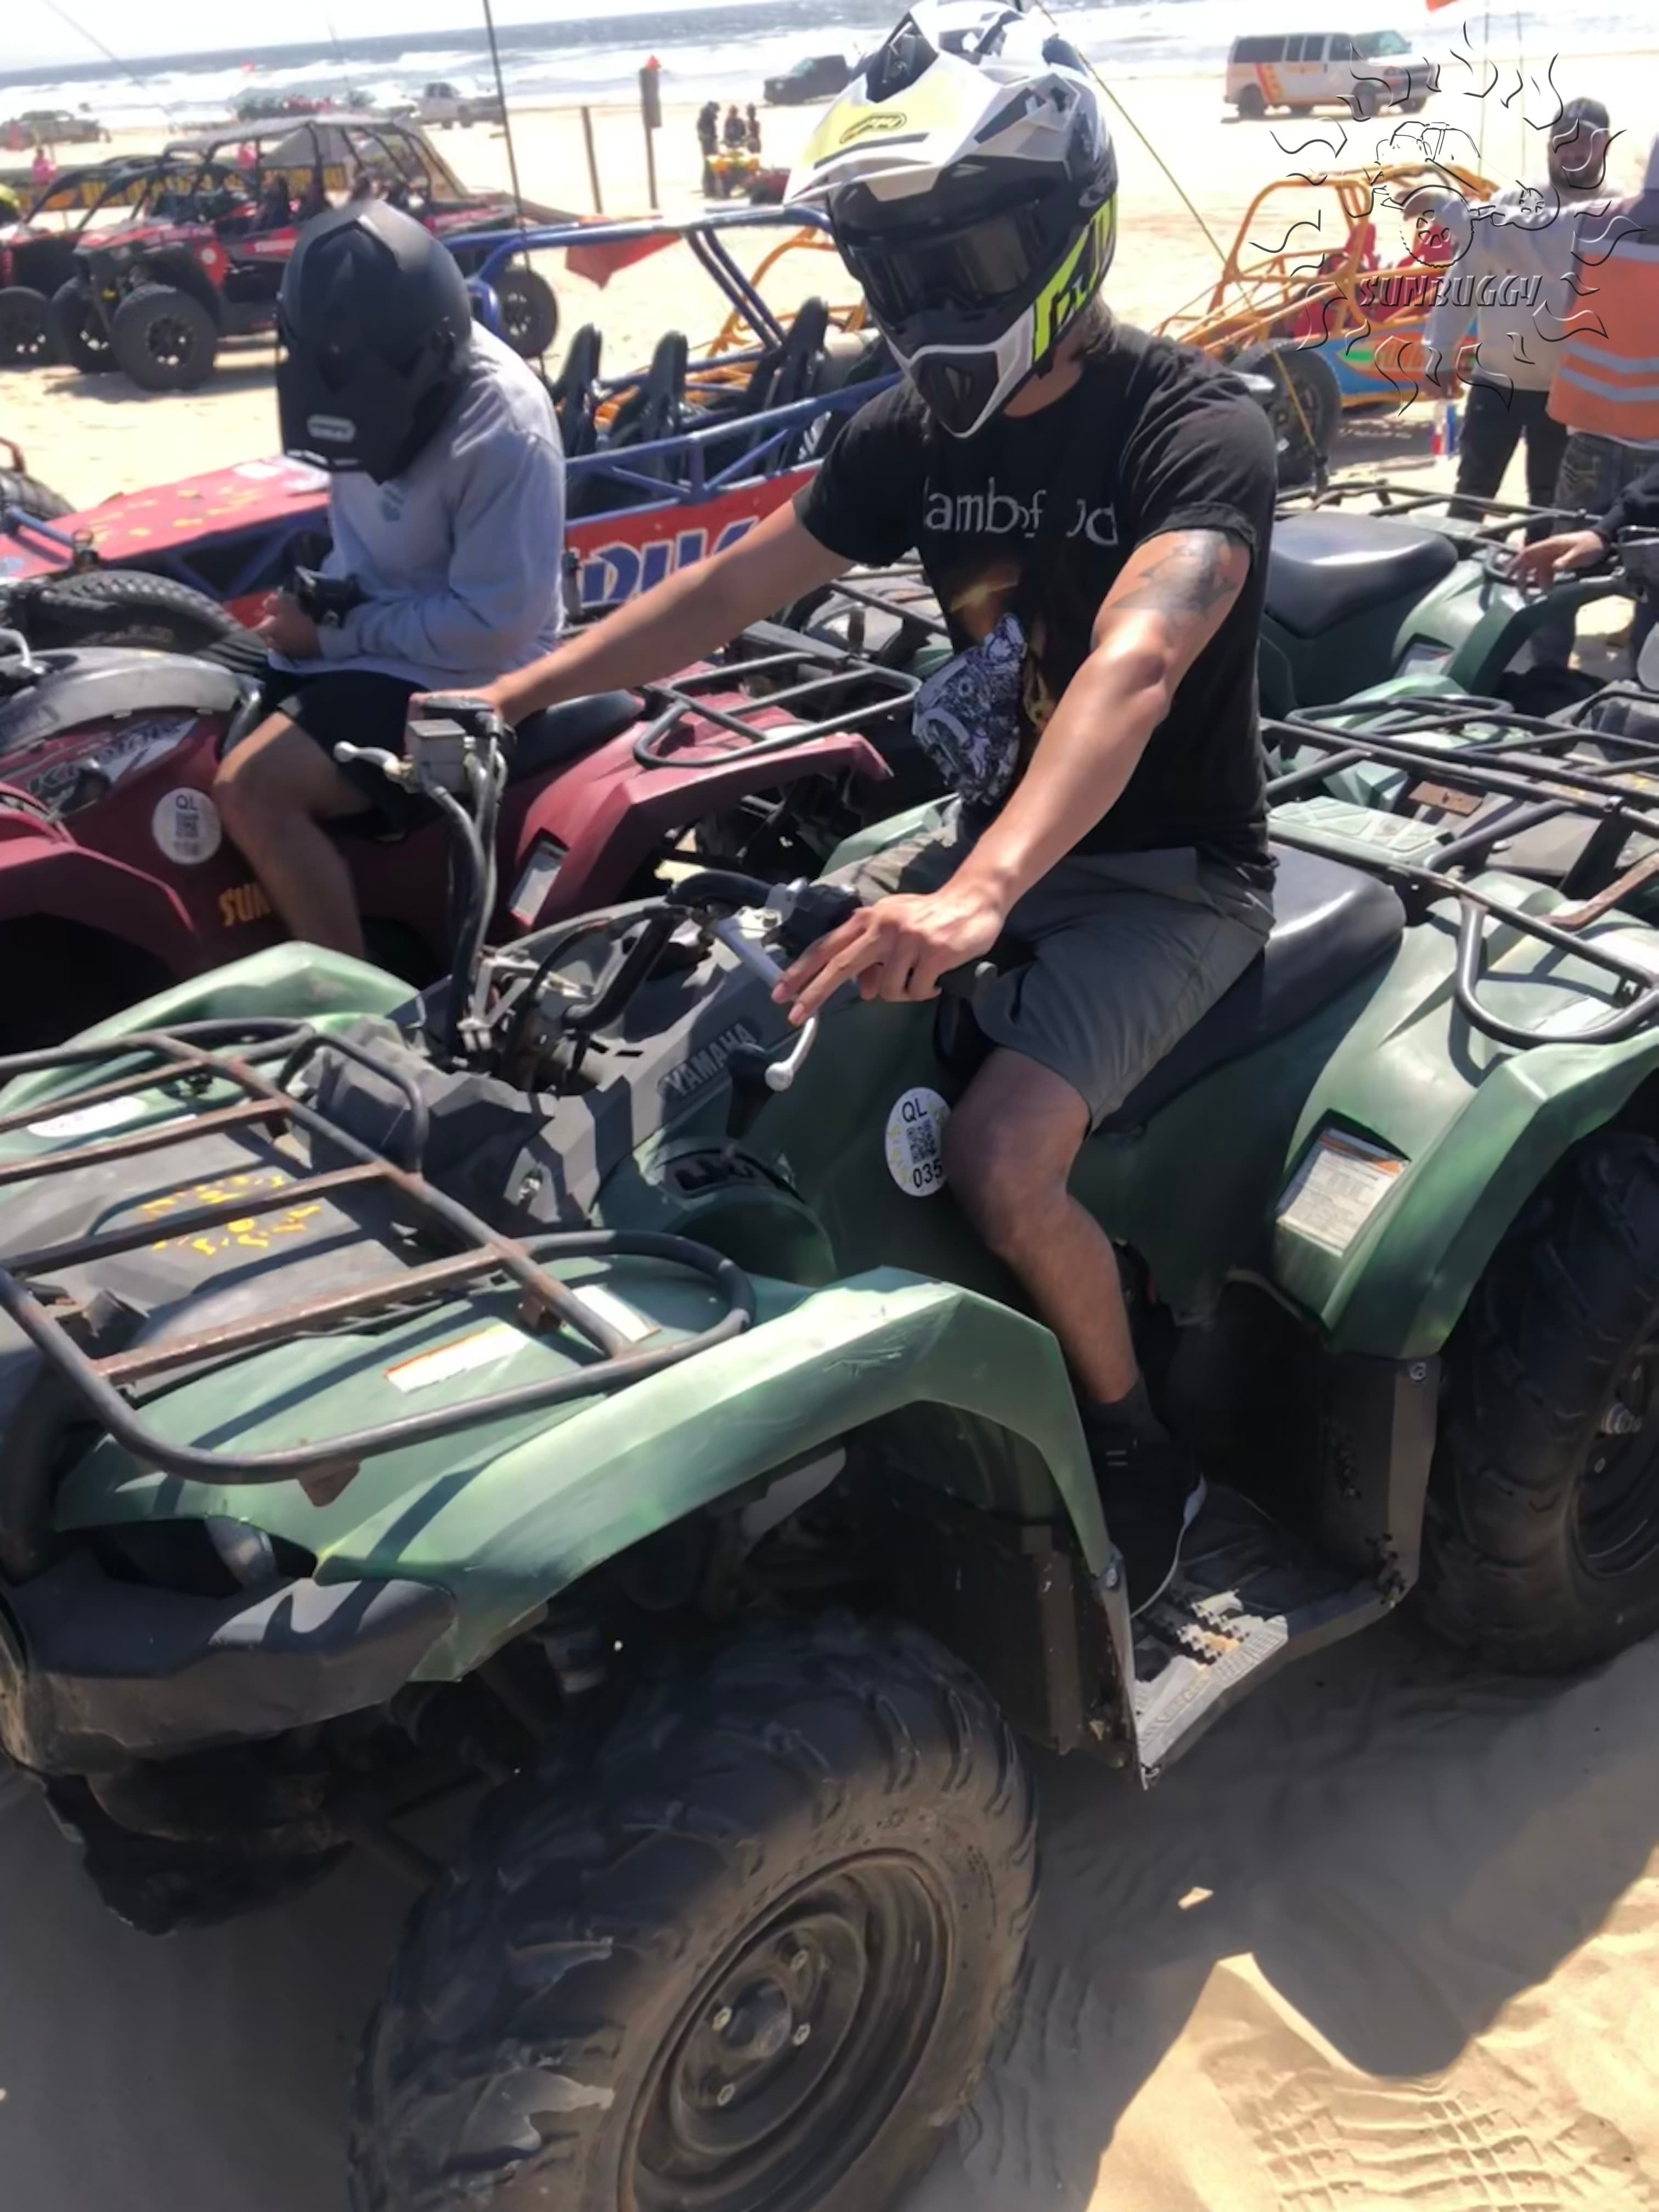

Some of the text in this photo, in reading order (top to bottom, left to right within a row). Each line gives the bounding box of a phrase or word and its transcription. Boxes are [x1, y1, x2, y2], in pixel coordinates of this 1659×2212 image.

[176, 794, 198, 811] QL
[664, 1023, 758, 1097] YAMAHA
[902, 1097, 927, 1122] QL
[913, 1158, 943, 1188] 035
